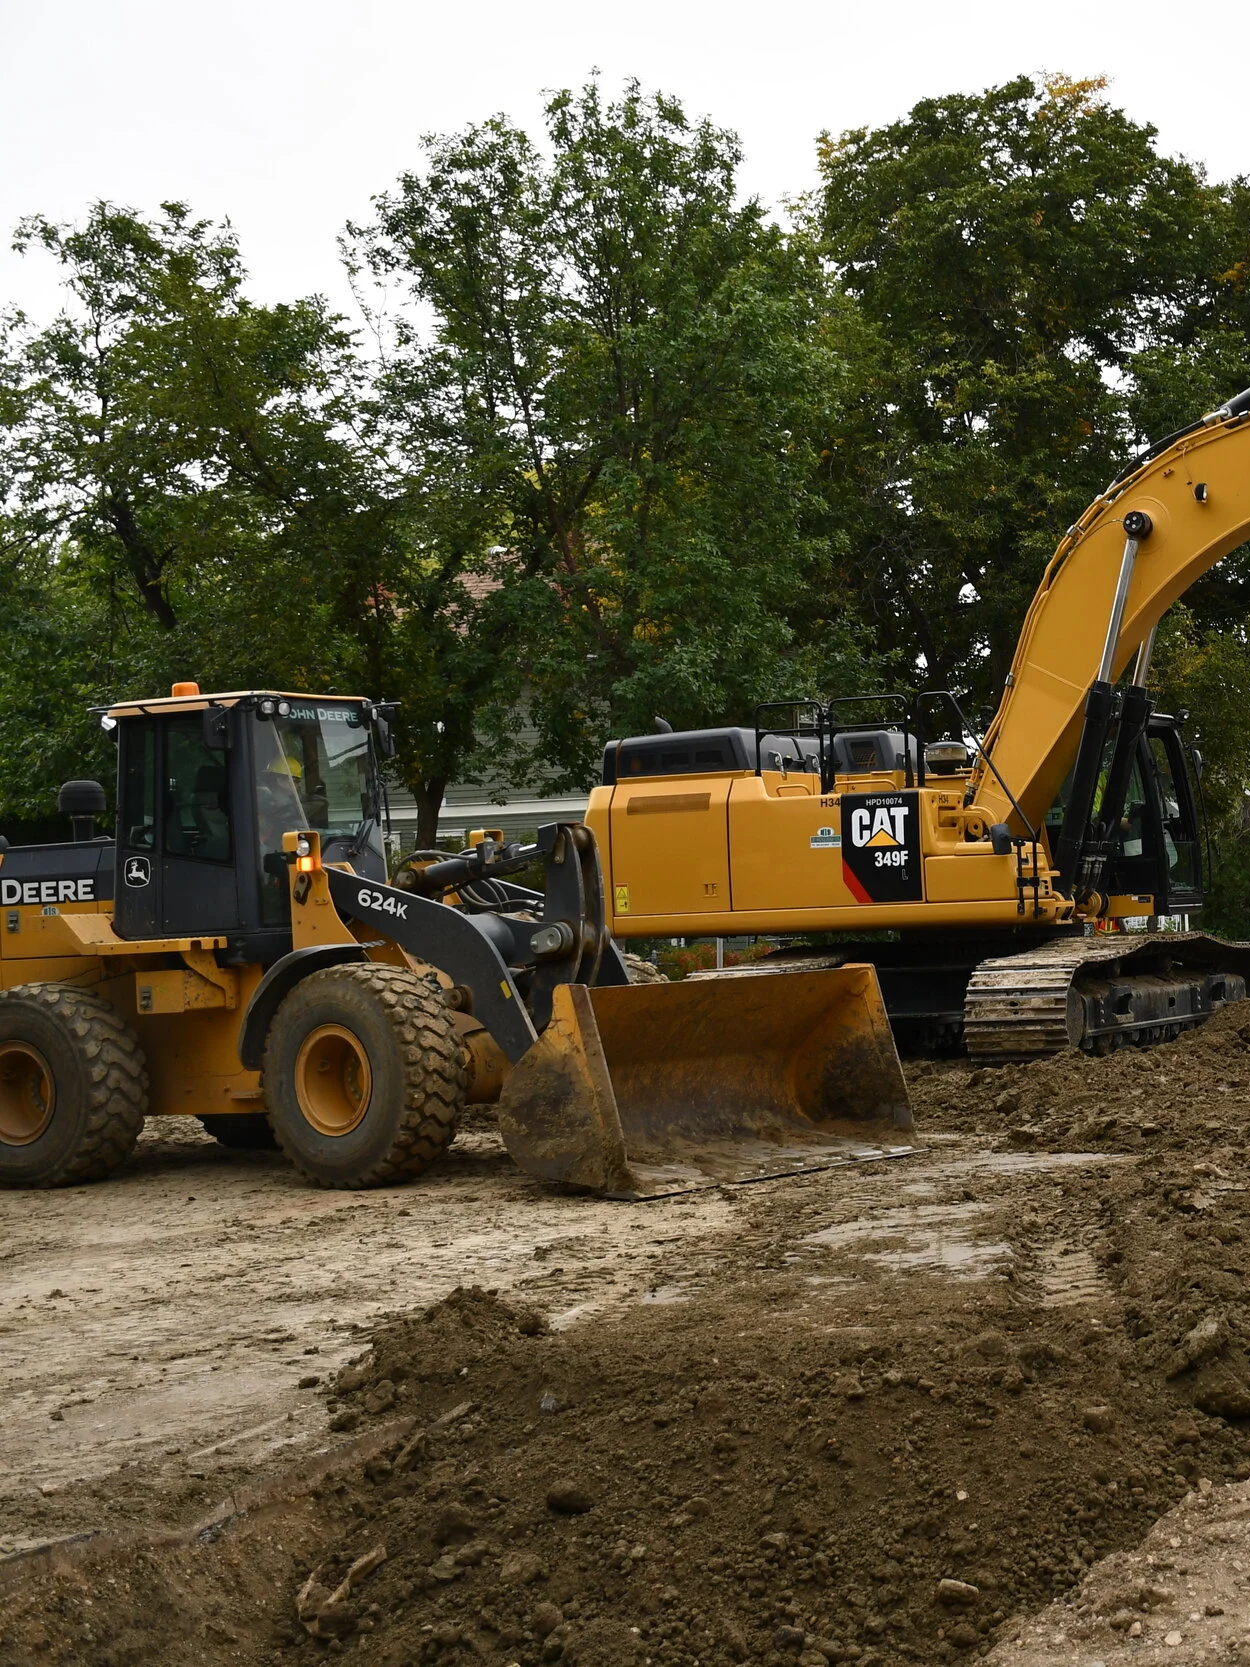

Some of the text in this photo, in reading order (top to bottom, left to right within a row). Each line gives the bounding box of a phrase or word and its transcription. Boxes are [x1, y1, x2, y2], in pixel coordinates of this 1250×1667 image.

[284, 708, 358, 721] OHN DEERE
[820, 798, 841, 808] H34
[865, 797, 903, 806] HPD10074
[851, 807, 909, 848] CAT
[874, 850, 909, 867] 349F
[1, 879, 95, 905] DEERE
[357, 888, 408, 920] 624K
